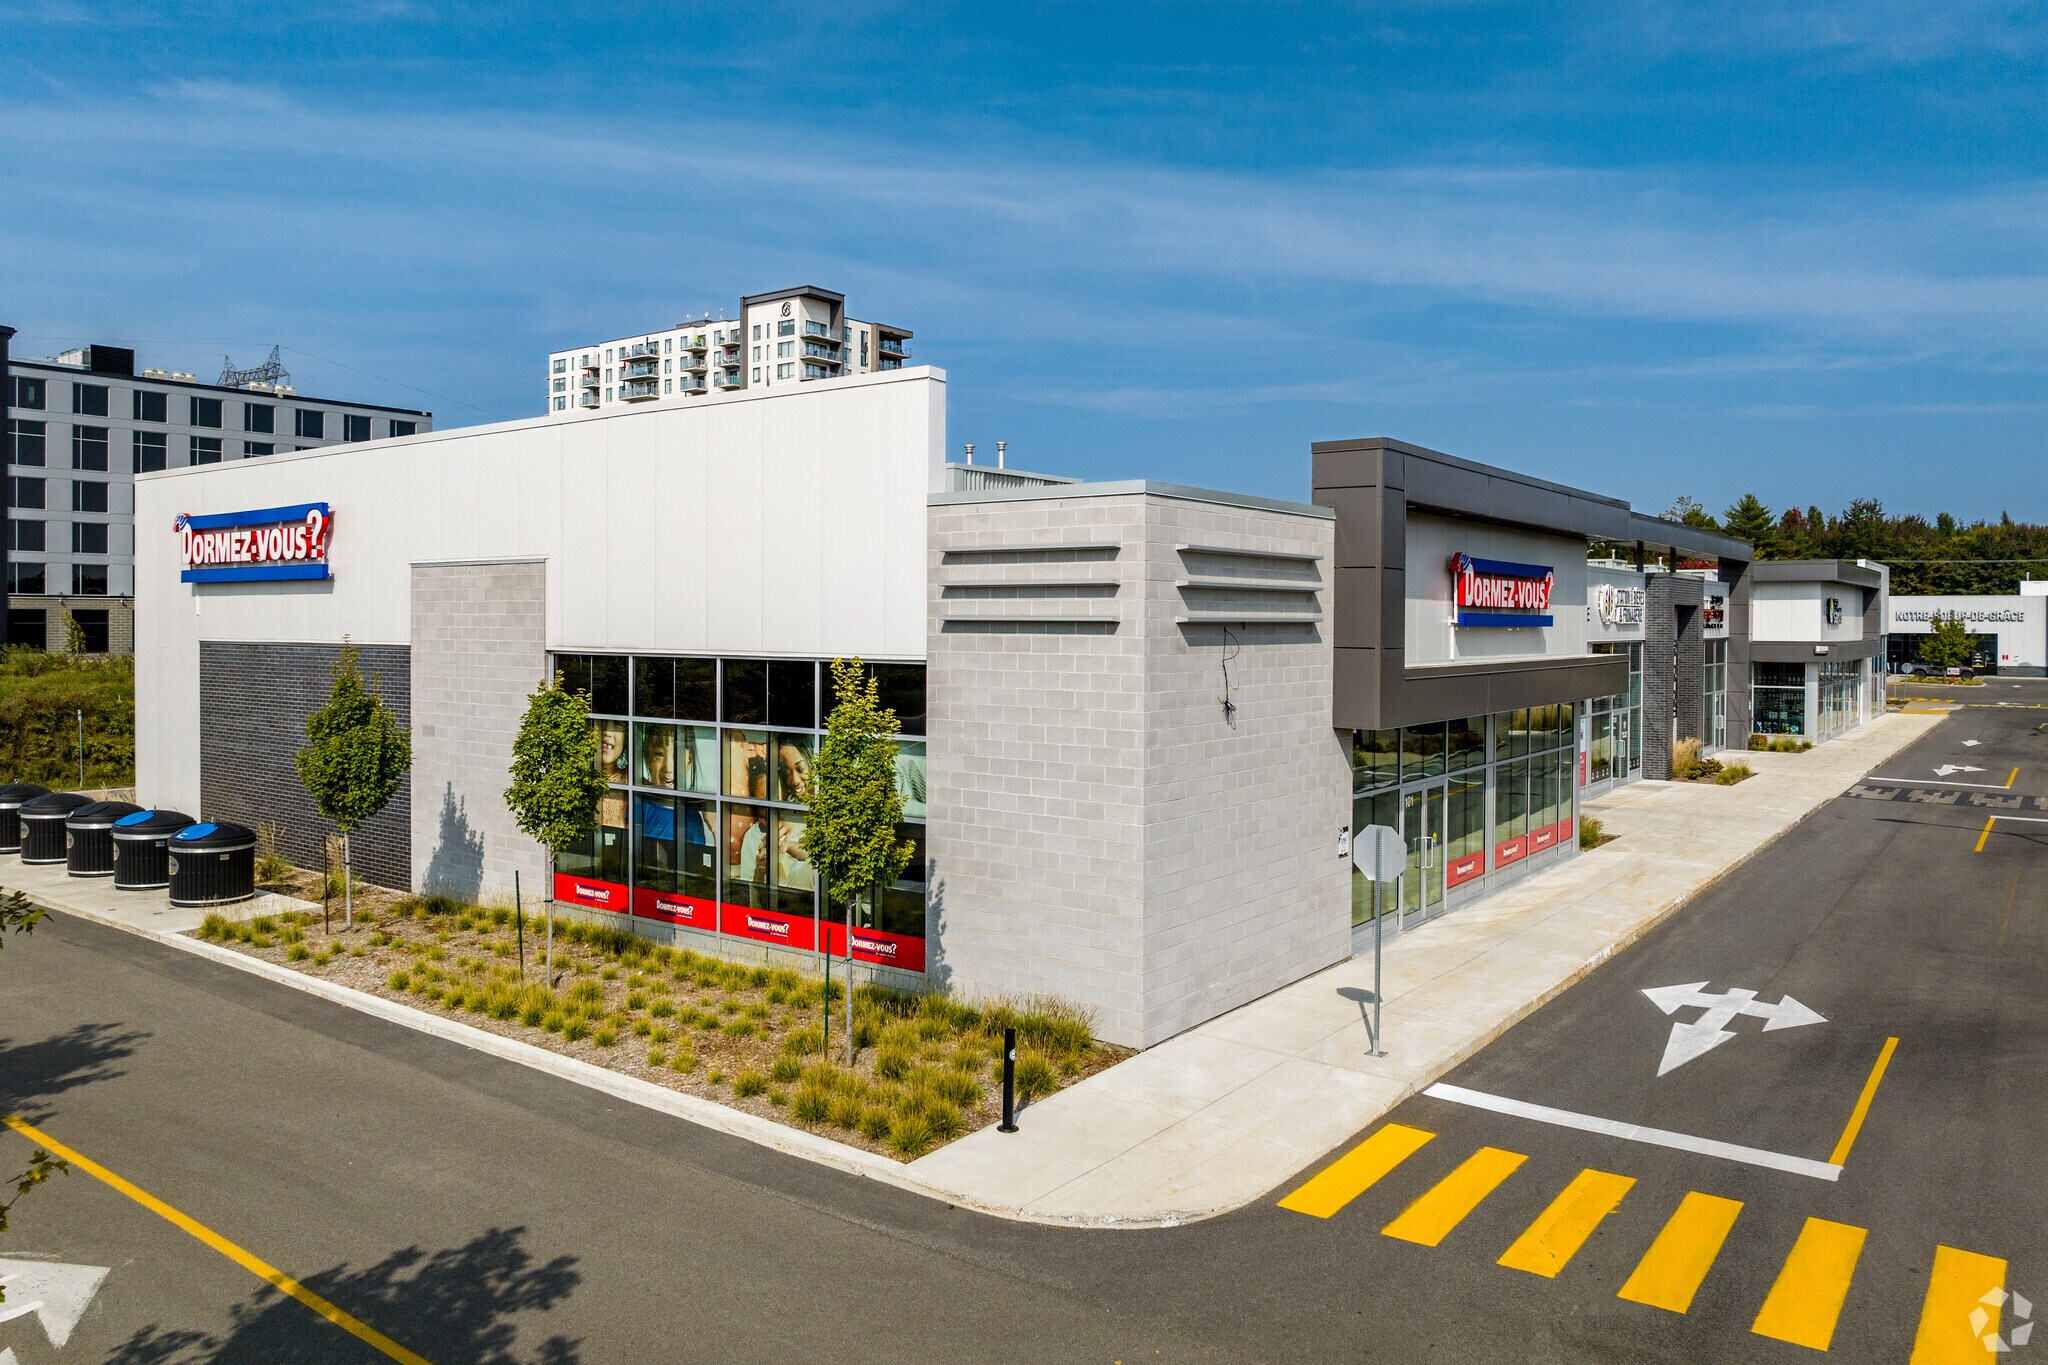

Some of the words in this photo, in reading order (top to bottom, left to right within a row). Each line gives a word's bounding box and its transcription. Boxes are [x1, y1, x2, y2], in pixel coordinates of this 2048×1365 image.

[181, 508, 322, 565] DORMEZ-VOUS?
[1465, 568, 1554, 609] DORMEZ-VOUS?
[576, 884, 610, 900] DORMEZ-VOUS?
[656, 900, 694, 915] DORMEZ-VOUS?
[747, 916, 789, 934] DORMEZ-VOUS?
